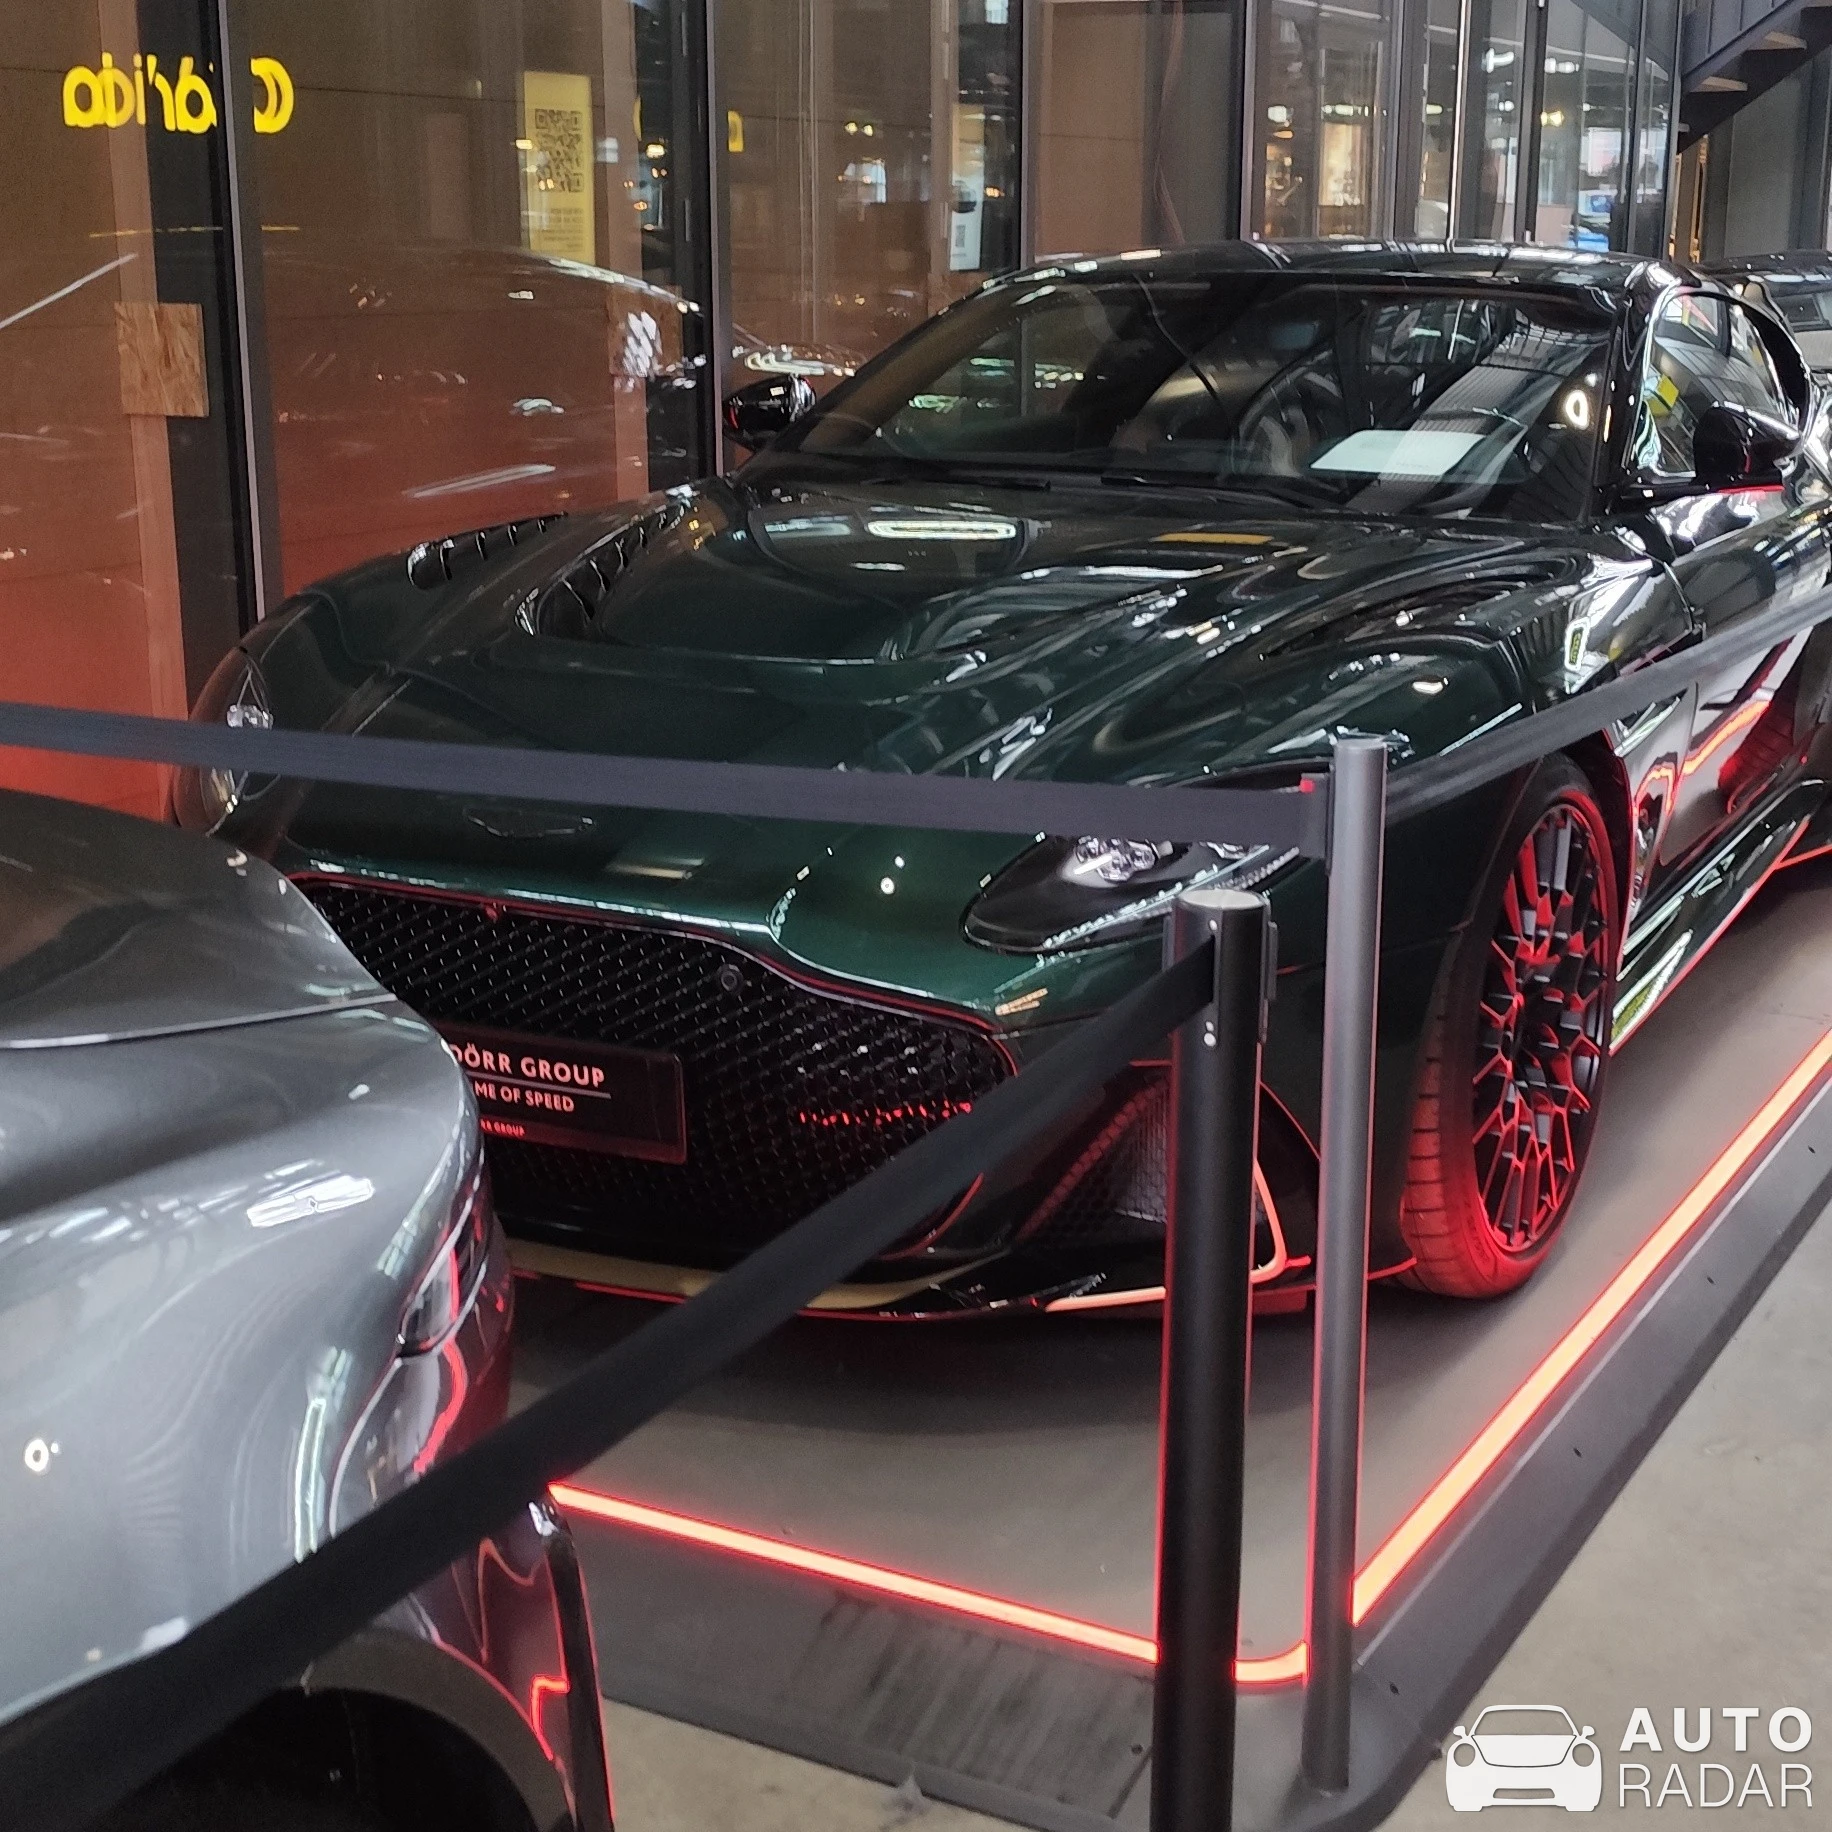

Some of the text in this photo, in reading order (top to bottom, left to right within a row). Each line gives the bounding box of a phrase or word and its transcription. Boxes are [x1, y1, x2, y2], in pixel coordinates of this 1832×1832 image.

[520, 1056, 605, 1088] GROUP
[500, 1086, 521, 1104] OF
[524, 1090, 575, 1112] SPEED
